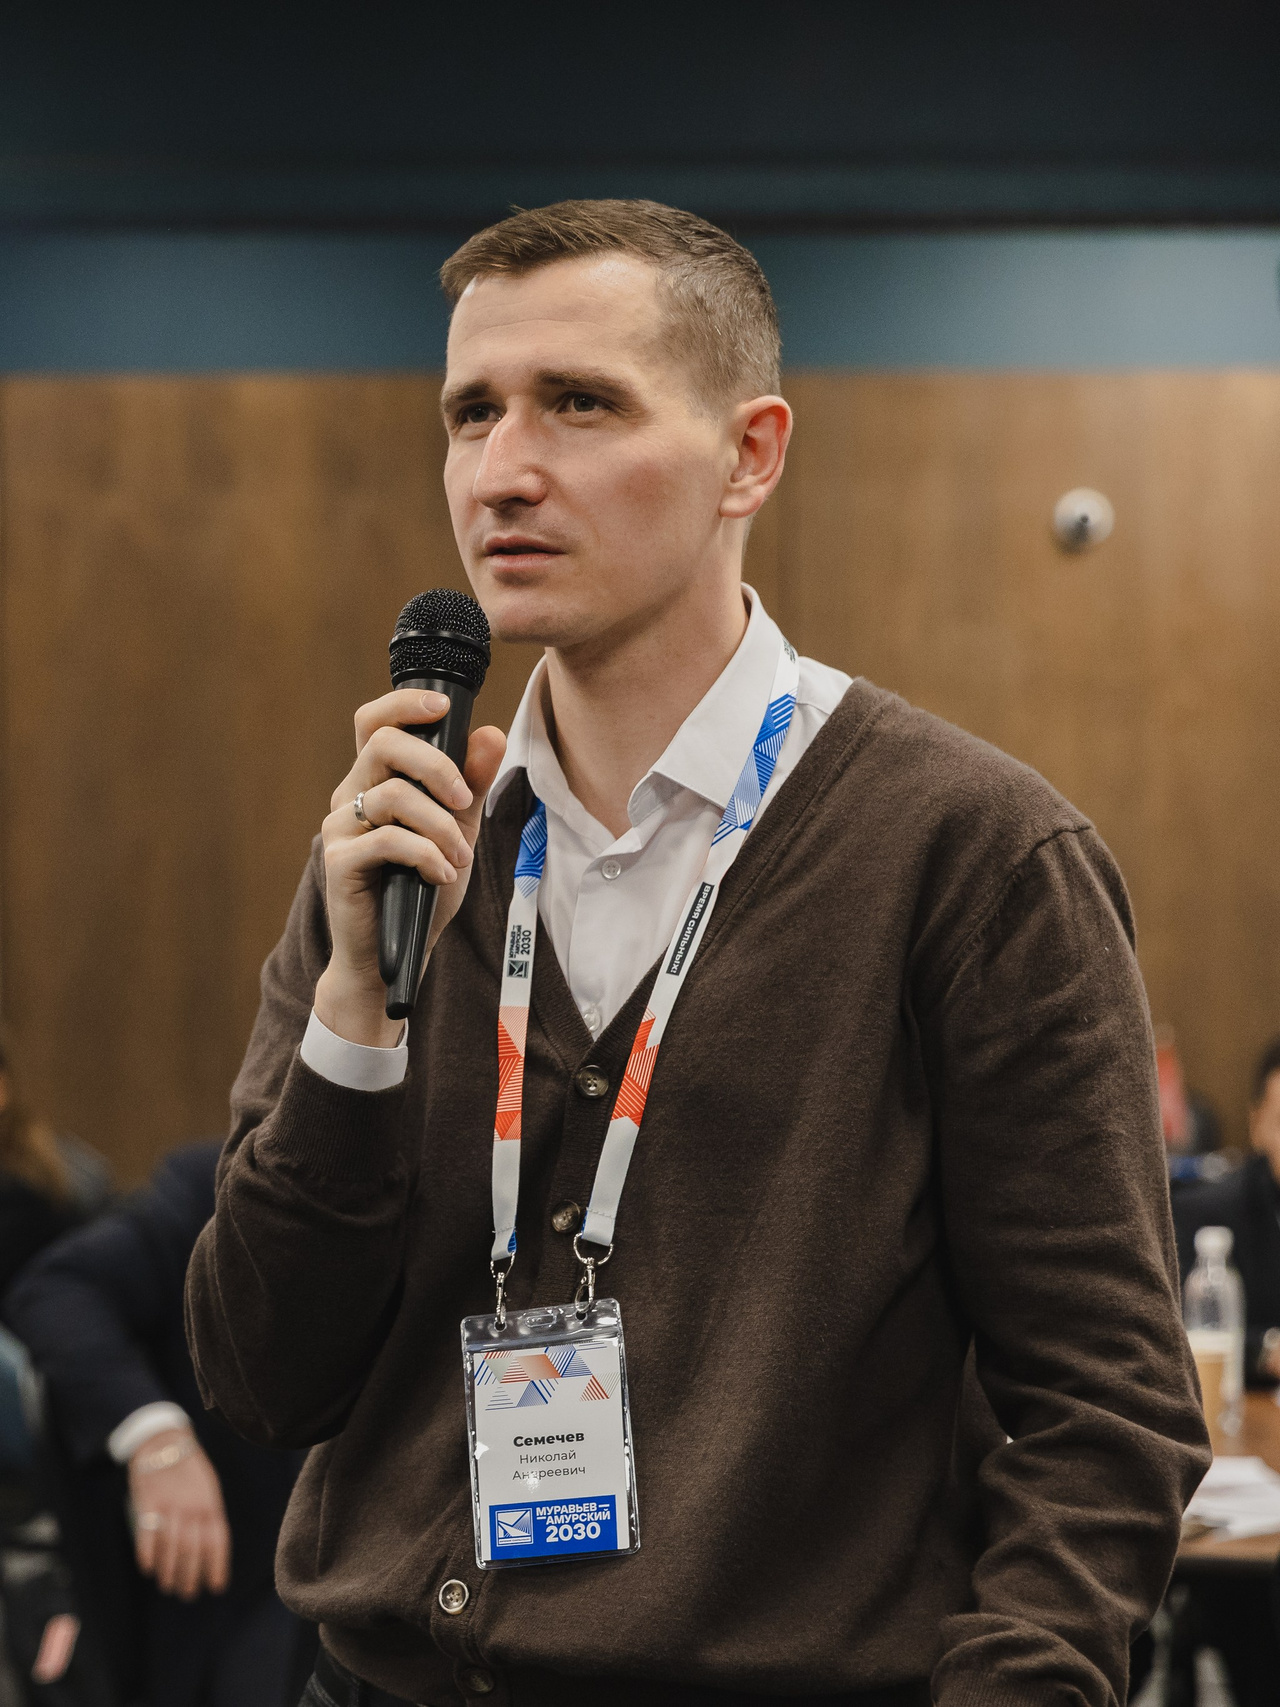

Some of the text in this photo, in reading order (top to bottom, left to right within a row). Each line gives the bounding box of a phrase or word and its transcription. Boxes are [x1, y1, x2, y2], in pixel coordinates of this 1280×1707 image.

[670, 885, 711, 973] ВРЕМЯ СИЛЬНЫХ!
[521, 930, 531, 955] 2030
[513, 1432, 585, 1447] Семечев
[519, 1449, 577, 1464] Николай
[545, 1521, 601, 1543] 2030
